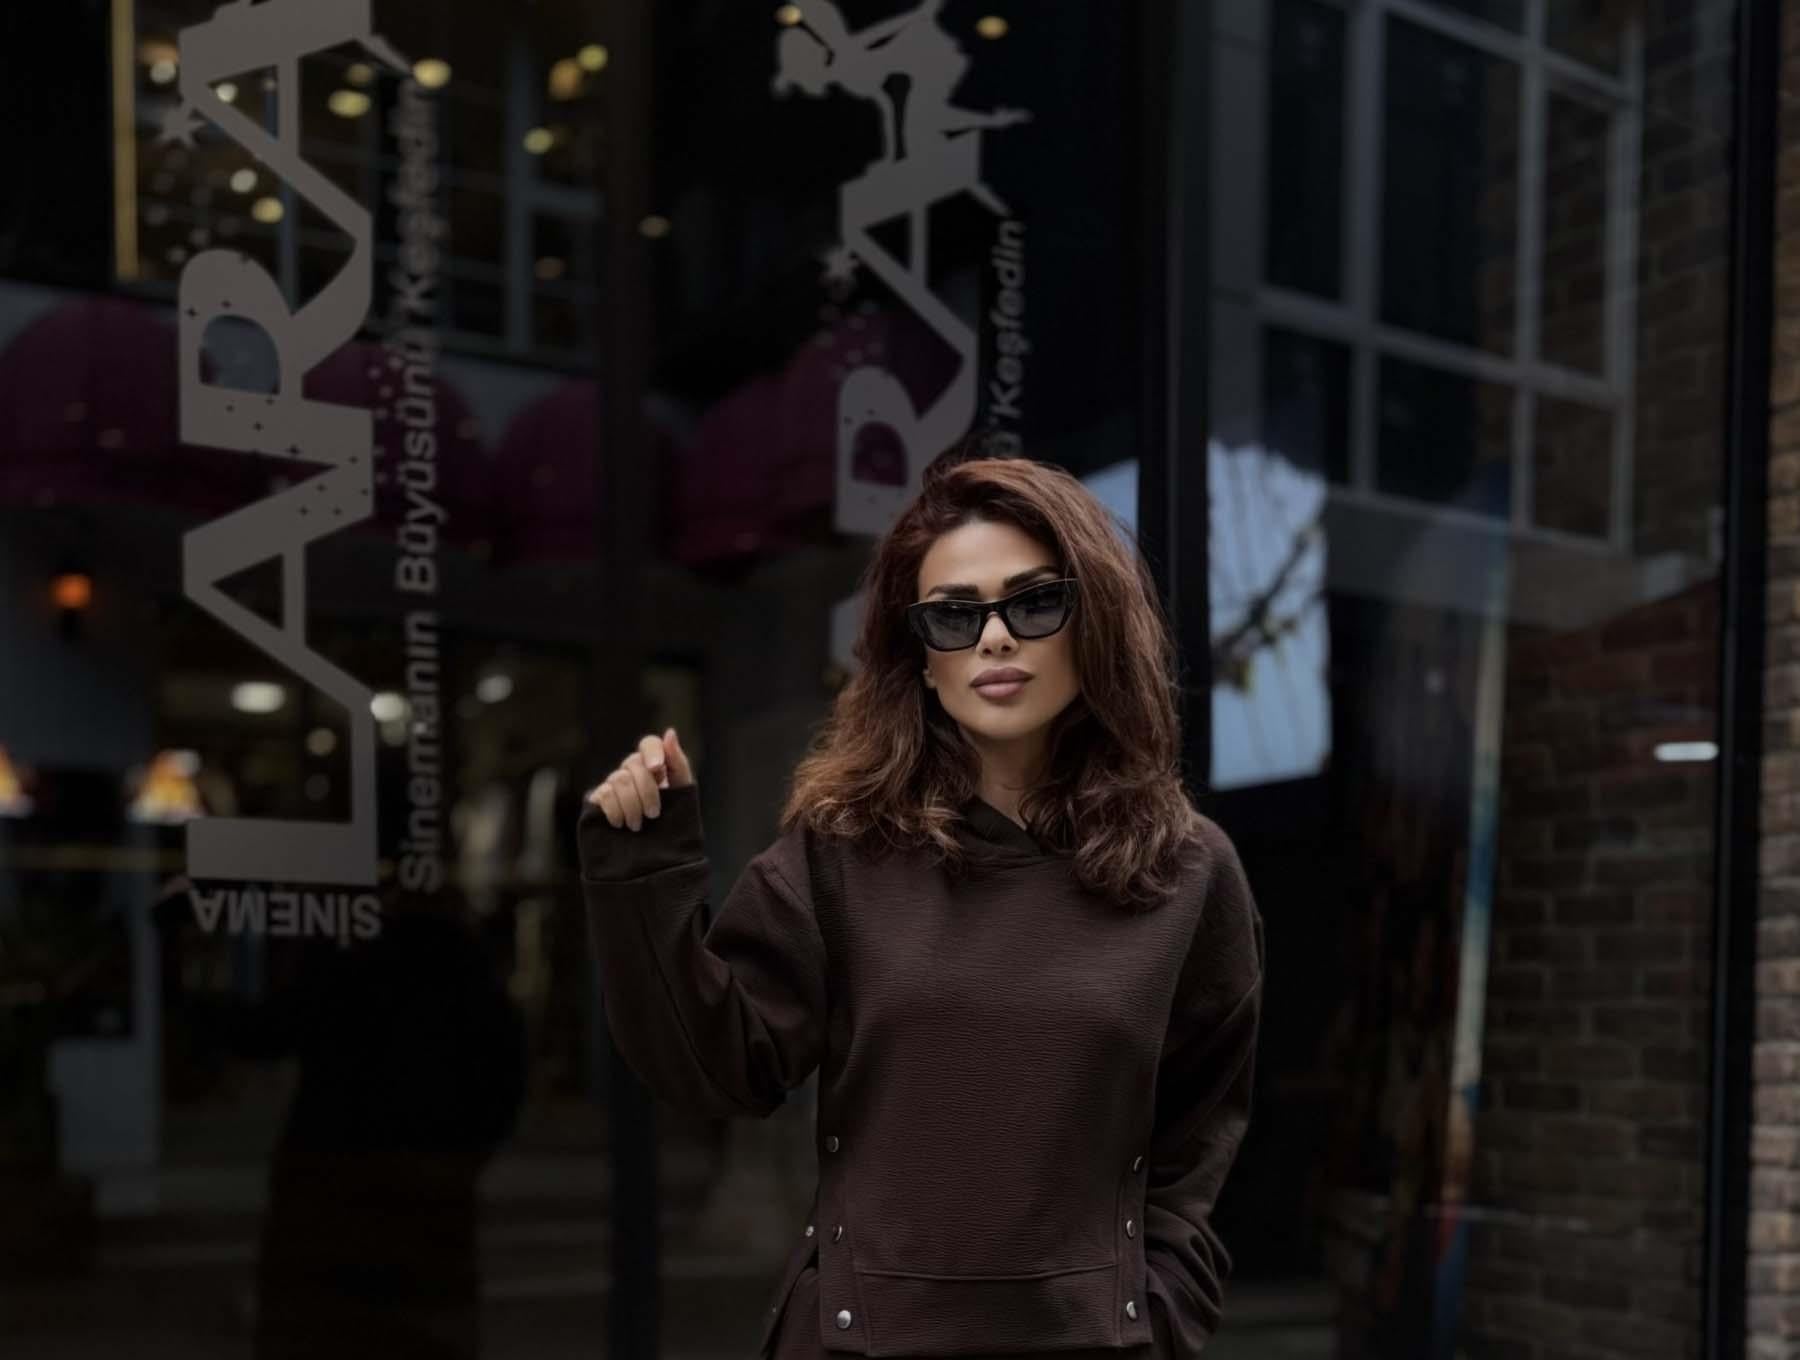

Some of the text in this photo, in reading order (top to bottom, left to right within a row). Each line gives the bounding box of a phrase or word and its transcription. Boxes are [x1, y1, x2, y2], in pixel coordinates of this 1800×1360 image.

[178, 0, 378, 887] LARA
[831, 128, 981, 668] RA
[989, 219, 1029, 418] Keşfedin
[395, 328, 448, 594] Büyüsünü
[398, 611, 445, 894] Sinemanın
[189, 882, 382, 949] SİNEMA
